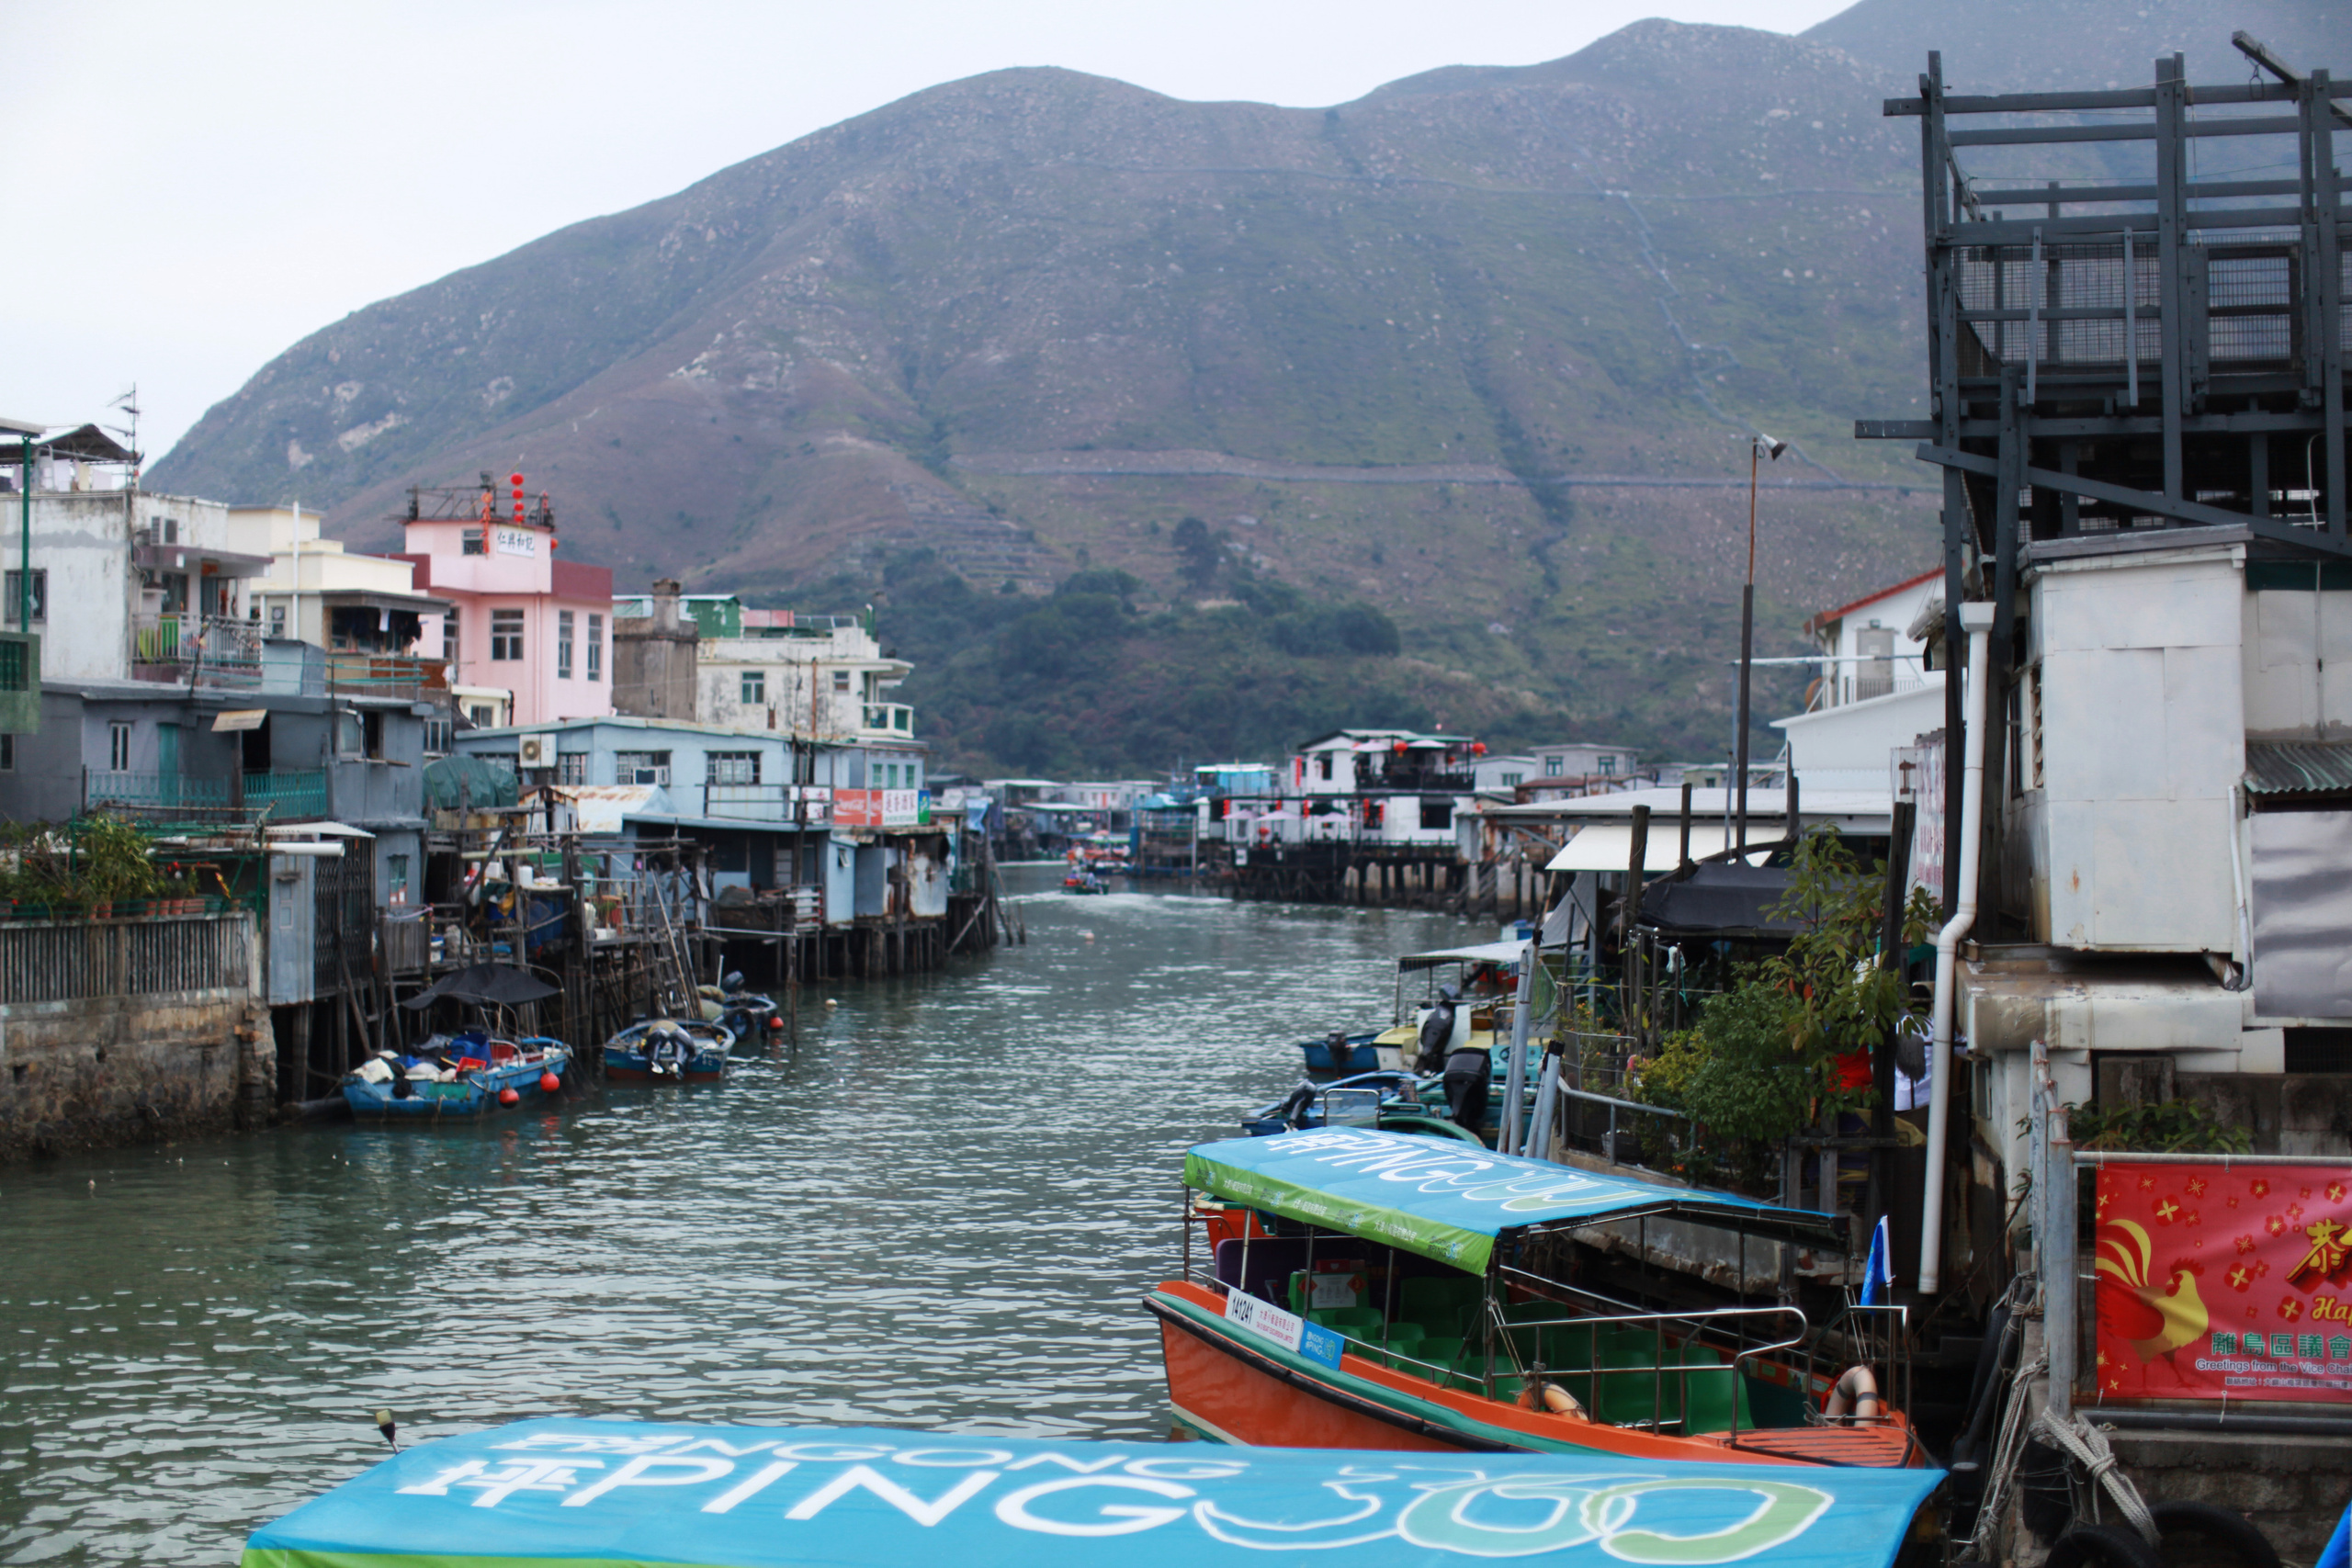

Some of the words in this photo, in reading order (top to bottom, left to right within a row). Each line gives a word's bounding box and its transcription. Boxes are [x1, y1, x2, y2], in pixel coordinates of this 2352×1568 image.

[2211, 1332, 2352, 1359] 離島區議會
[2196, 1359, 2250, 1373] Greetings
[2251, 1360, 2277, 1371] from
[2280, 1363, 2297, 1372] the
[2299, 1362, 2324, 1373] Vice
